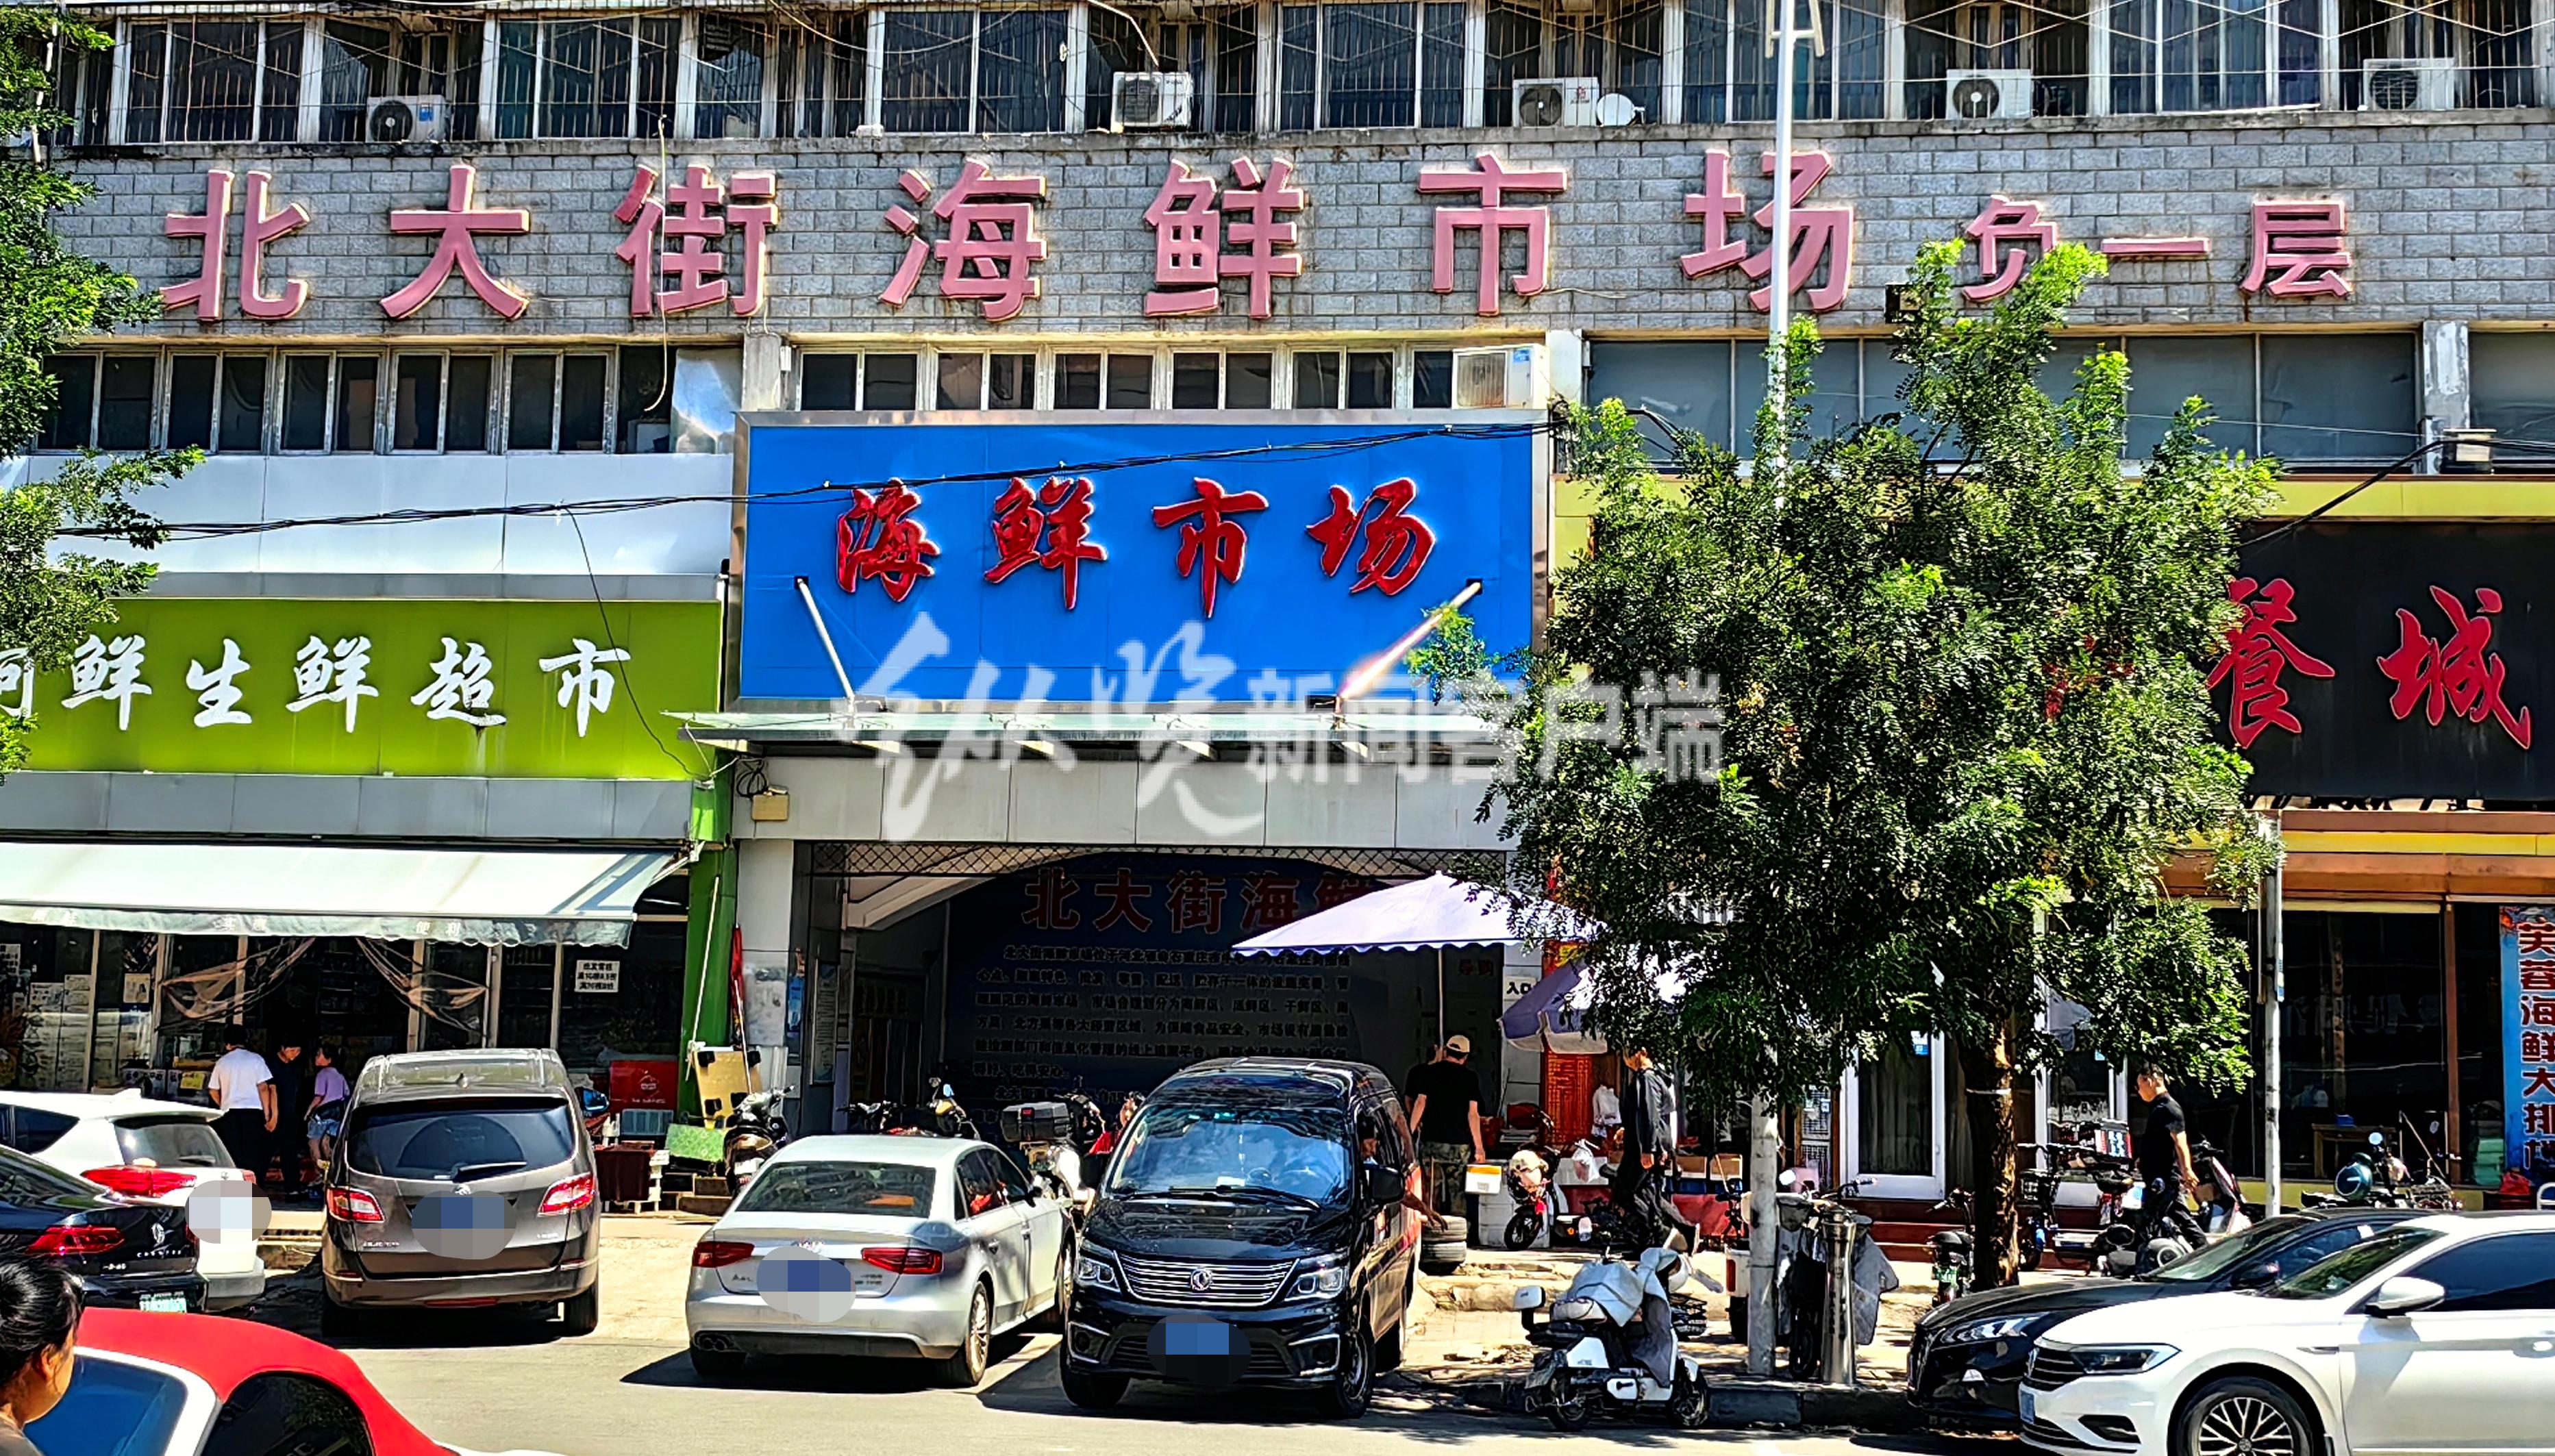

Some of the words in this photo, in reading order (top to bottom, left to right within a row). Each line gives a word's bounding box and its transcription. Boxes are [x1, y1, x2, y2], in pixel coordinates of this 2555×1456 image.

[159, 149, 1855, 323] 北大街海鲜市场
[1962, 194, 2352, 301] 负一层
[836, 475, 1436, 619] 海鲜市场
[2043, 575, 2532, 751] 餐城
